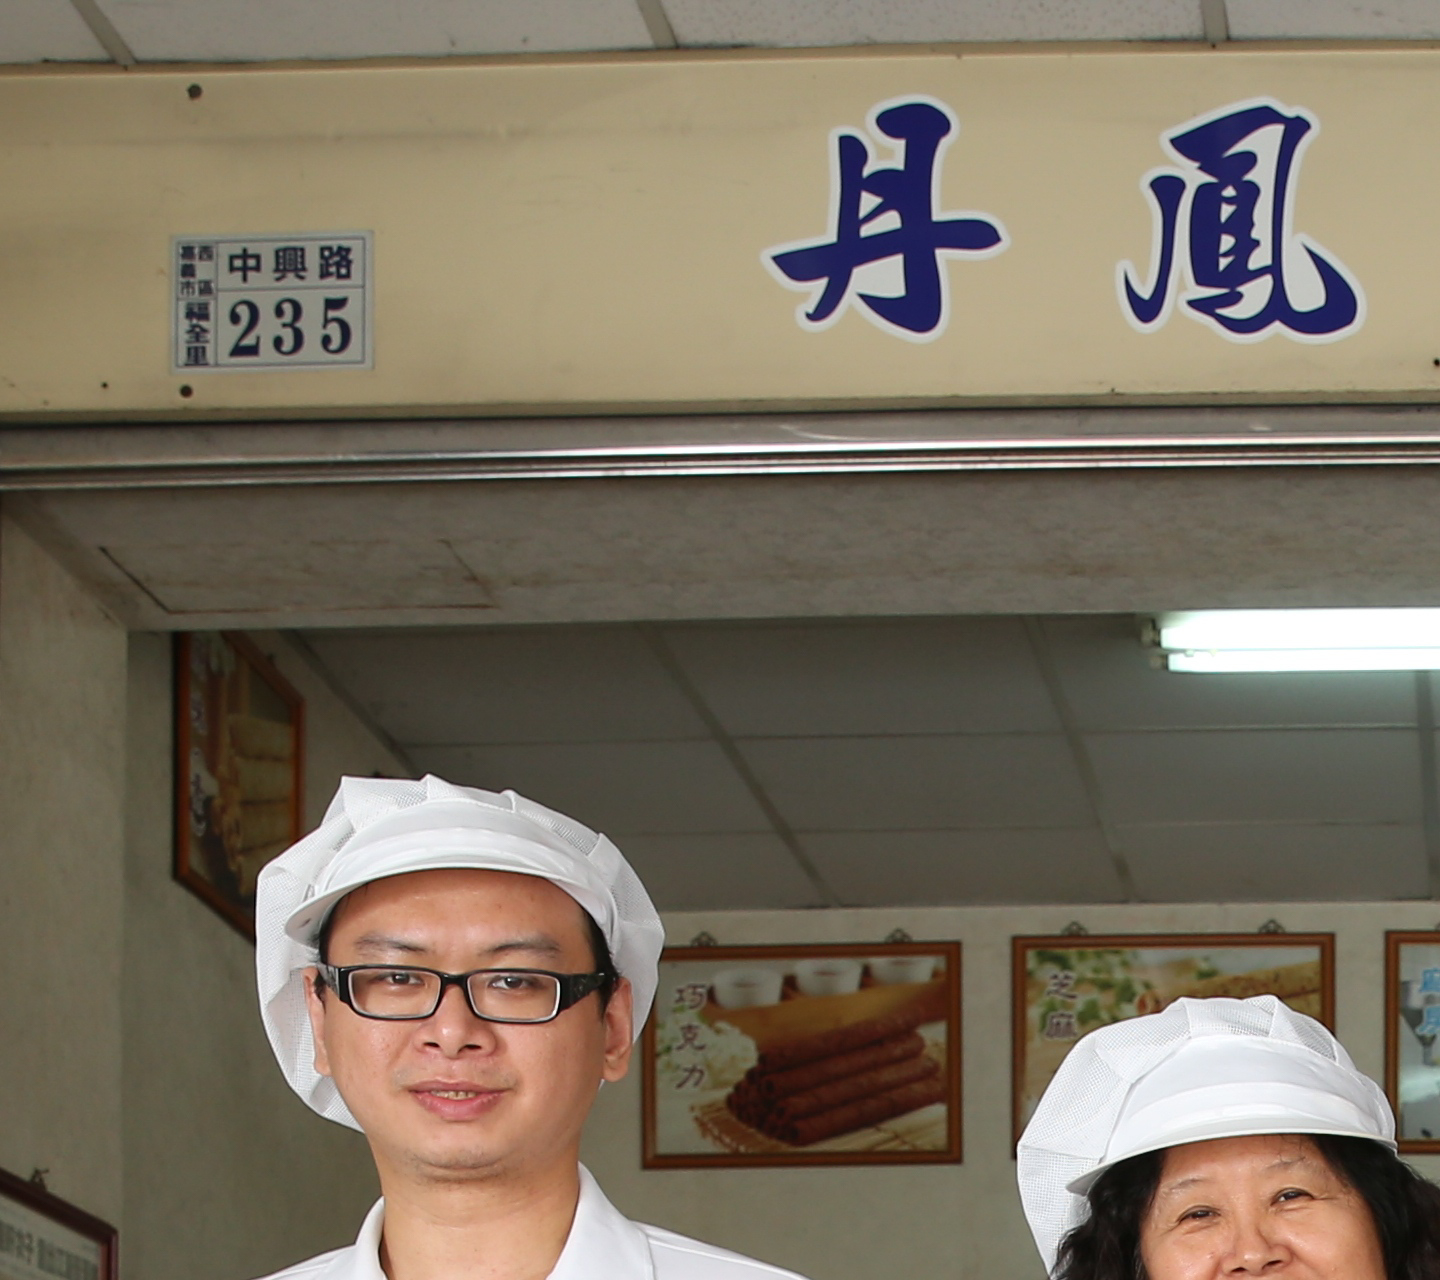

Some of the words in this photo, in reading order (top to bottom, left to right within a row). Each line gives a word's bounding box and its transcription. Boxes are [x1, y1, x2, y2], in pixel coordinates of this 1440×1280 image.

[229, 246, 353, 283] 中興路
[185, 302, 210, 366] 福全里
[229, 297, 351, 357] 235
[674, 982, 707, 1089] 巧克力
[1045, 972, 1078, 1039] 芝麻
